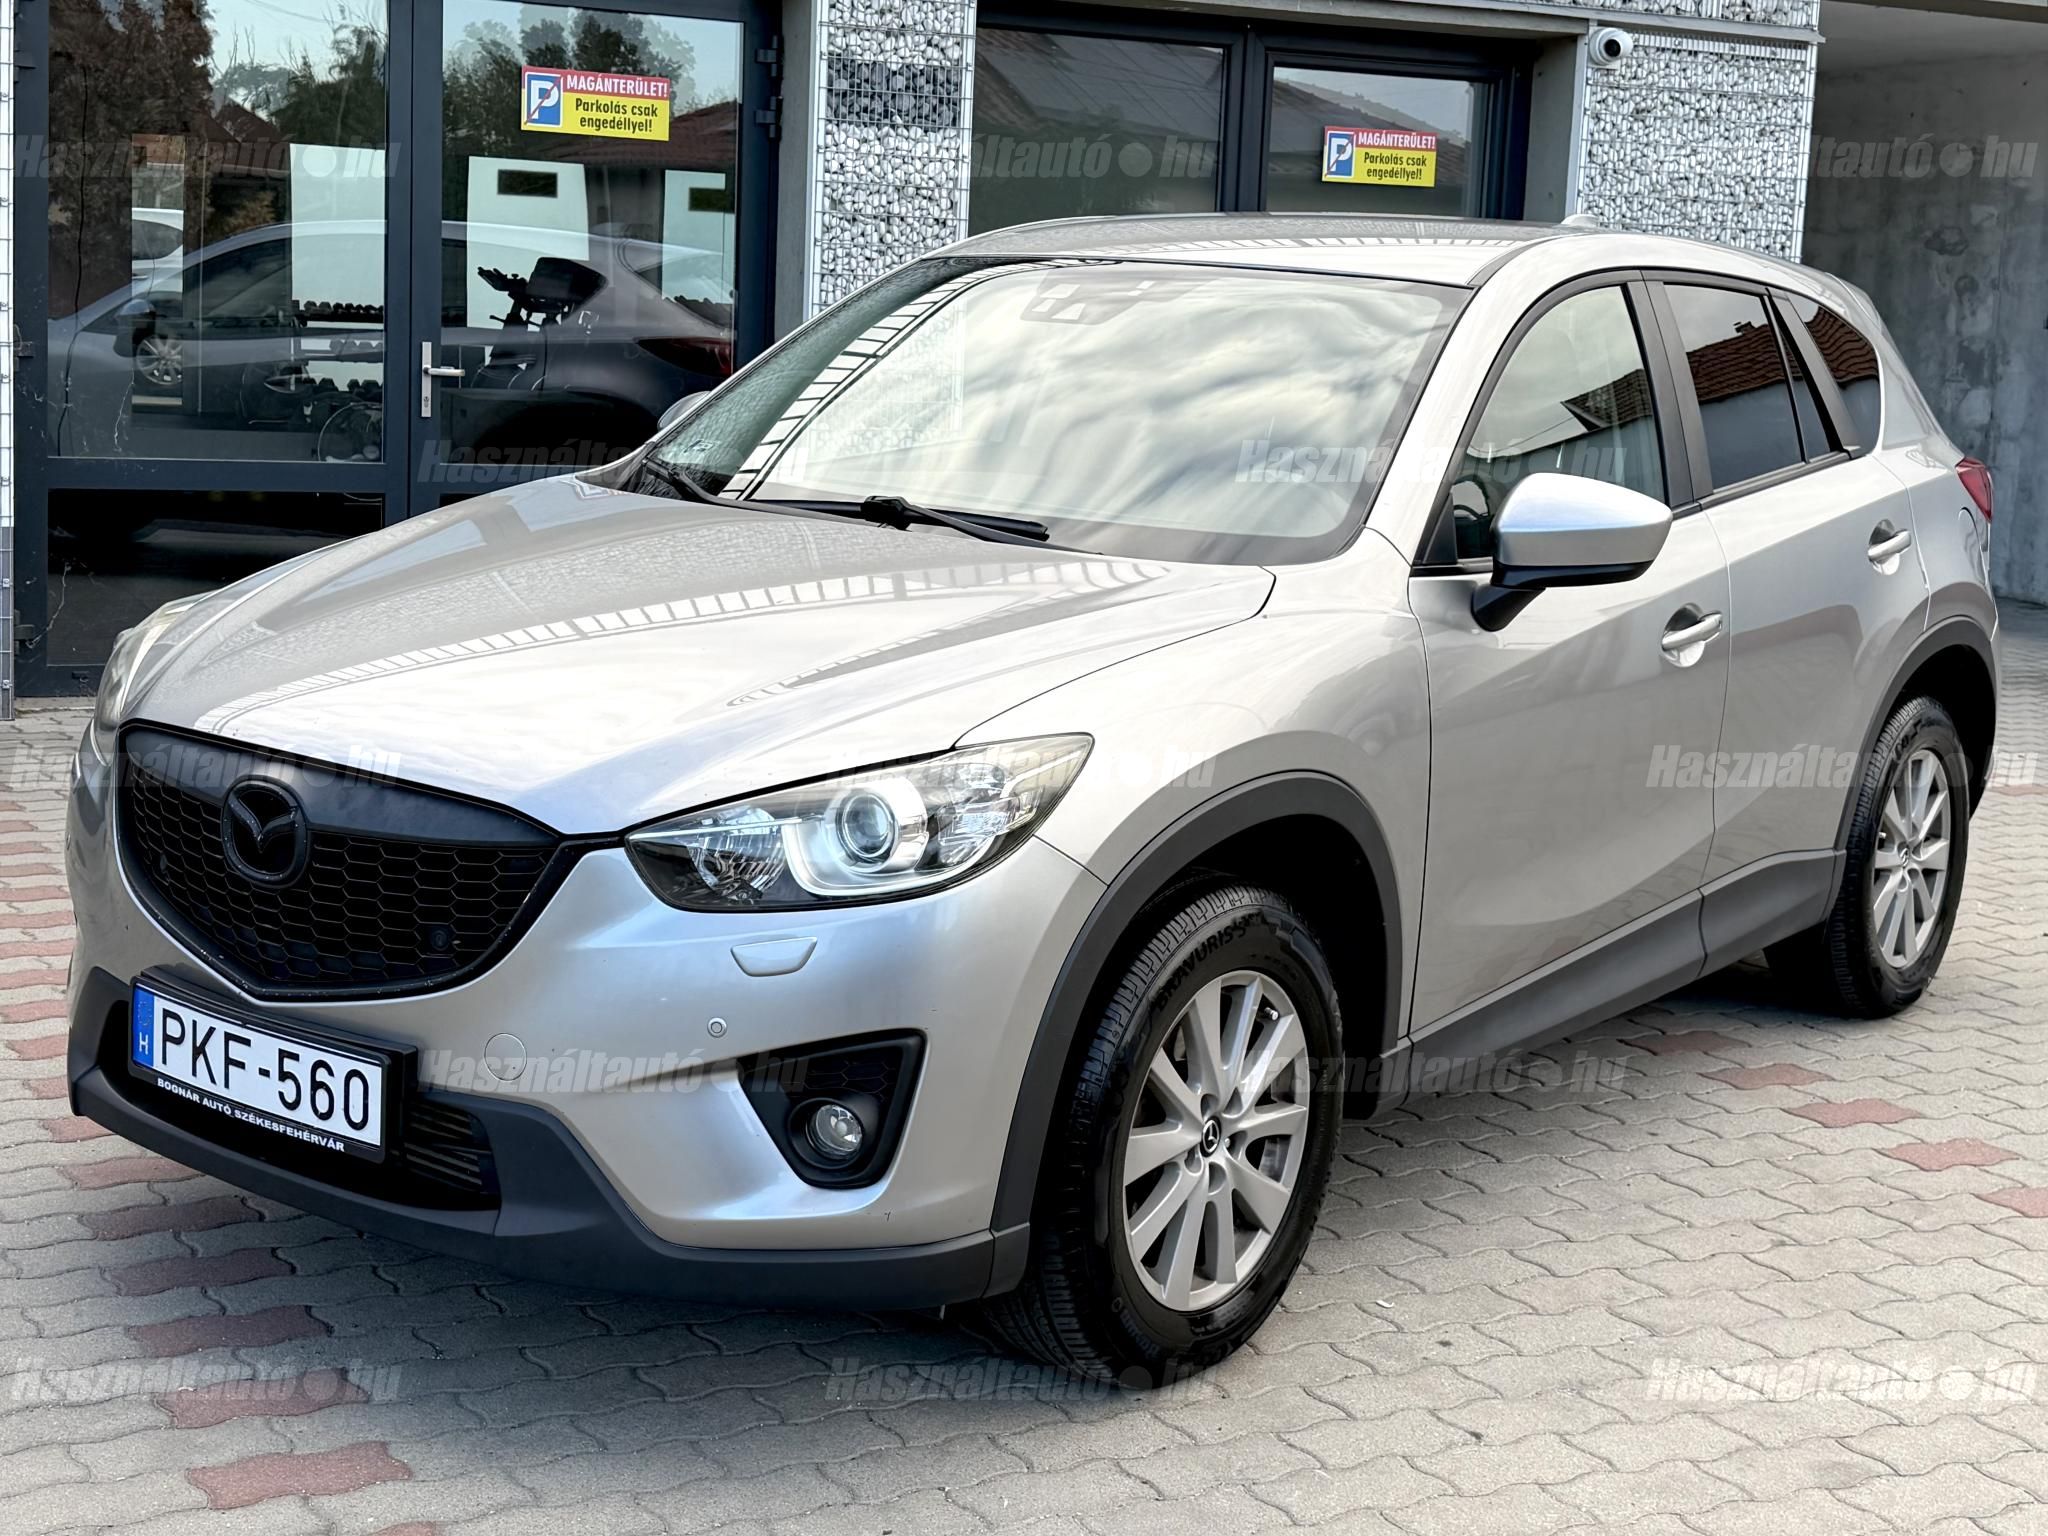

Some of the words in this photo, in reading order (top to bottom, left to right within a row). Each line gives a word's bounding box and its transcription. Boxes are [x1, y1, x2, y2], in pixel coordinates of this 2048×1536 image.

[566, 74, 668, 98] MAGÁNTERÜLET!
[575, 98, 628, 115] Parkolás
[631, 103, 658, 118] csak
[579, 116, 653, 134] engedéllyel!
[1358, 130, 1436, 149] MAGÁNTERÜLET!
[1364, 152, 1404, 166] Parkolás
[1406, 154, 1427, 167] csak
[1367, 167, 1422, 182] engedéllyel!
[138, 1031, 149, 1055] H
[161, 1007, 370, 1131] PKF-560
[157, 1076, 200, 1104] BOGNÁR
[202, 1097, 232, 1116] AUTÓ
[234, 1108, 345, 1152] SZÉKESFEHÉRVÁR
